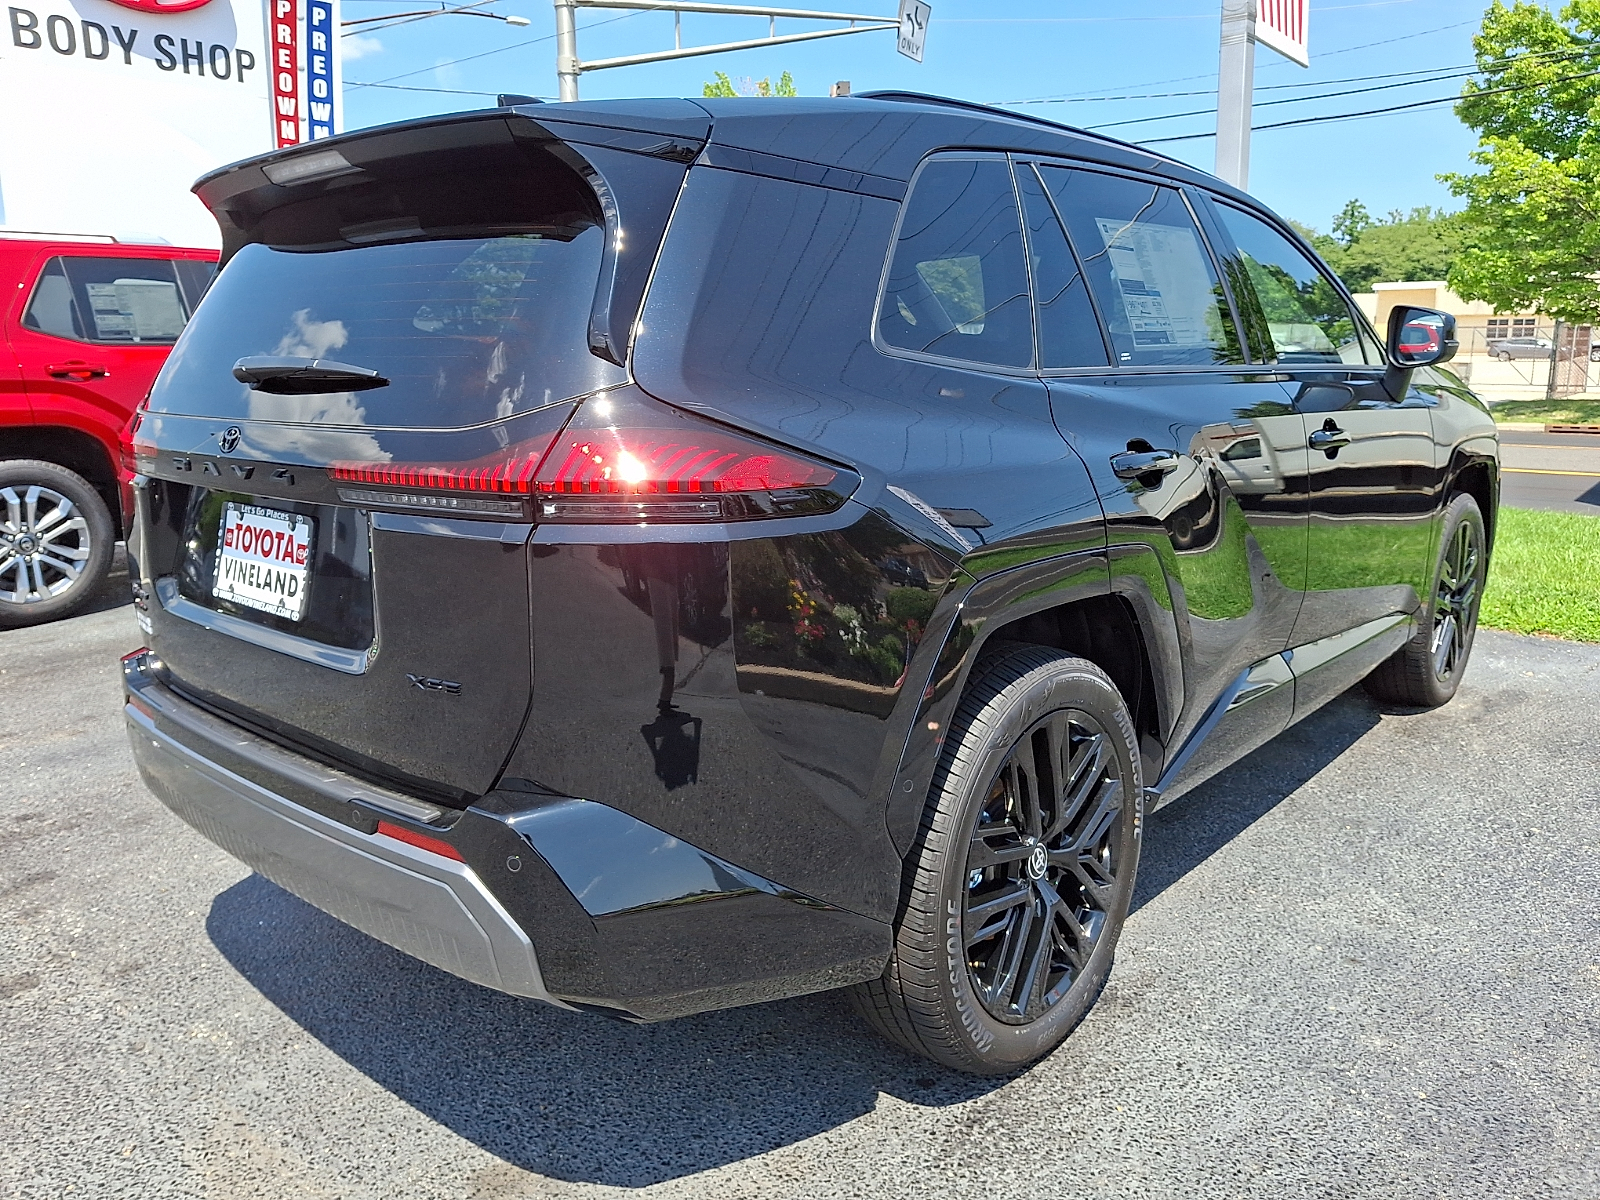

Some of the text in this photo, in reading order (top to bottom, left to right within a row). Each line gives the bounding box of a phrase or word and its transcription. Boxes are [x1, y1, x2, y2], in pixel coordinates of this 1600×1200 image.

[8, 6, 256, 83] BODY SHOP
[901, 37, 920, 55] ONLY
[276, 0, 297, 149] PREOWN
[172, 457, 295, 486] RAV4
[256, 507, 265, 516] Go
[266, 509, 289, 521] Places
[234, 523, 295, 564] TOYOTA
[225, 557, 298, 597] VINELAND
[404, 672, 462, 697] XSE
